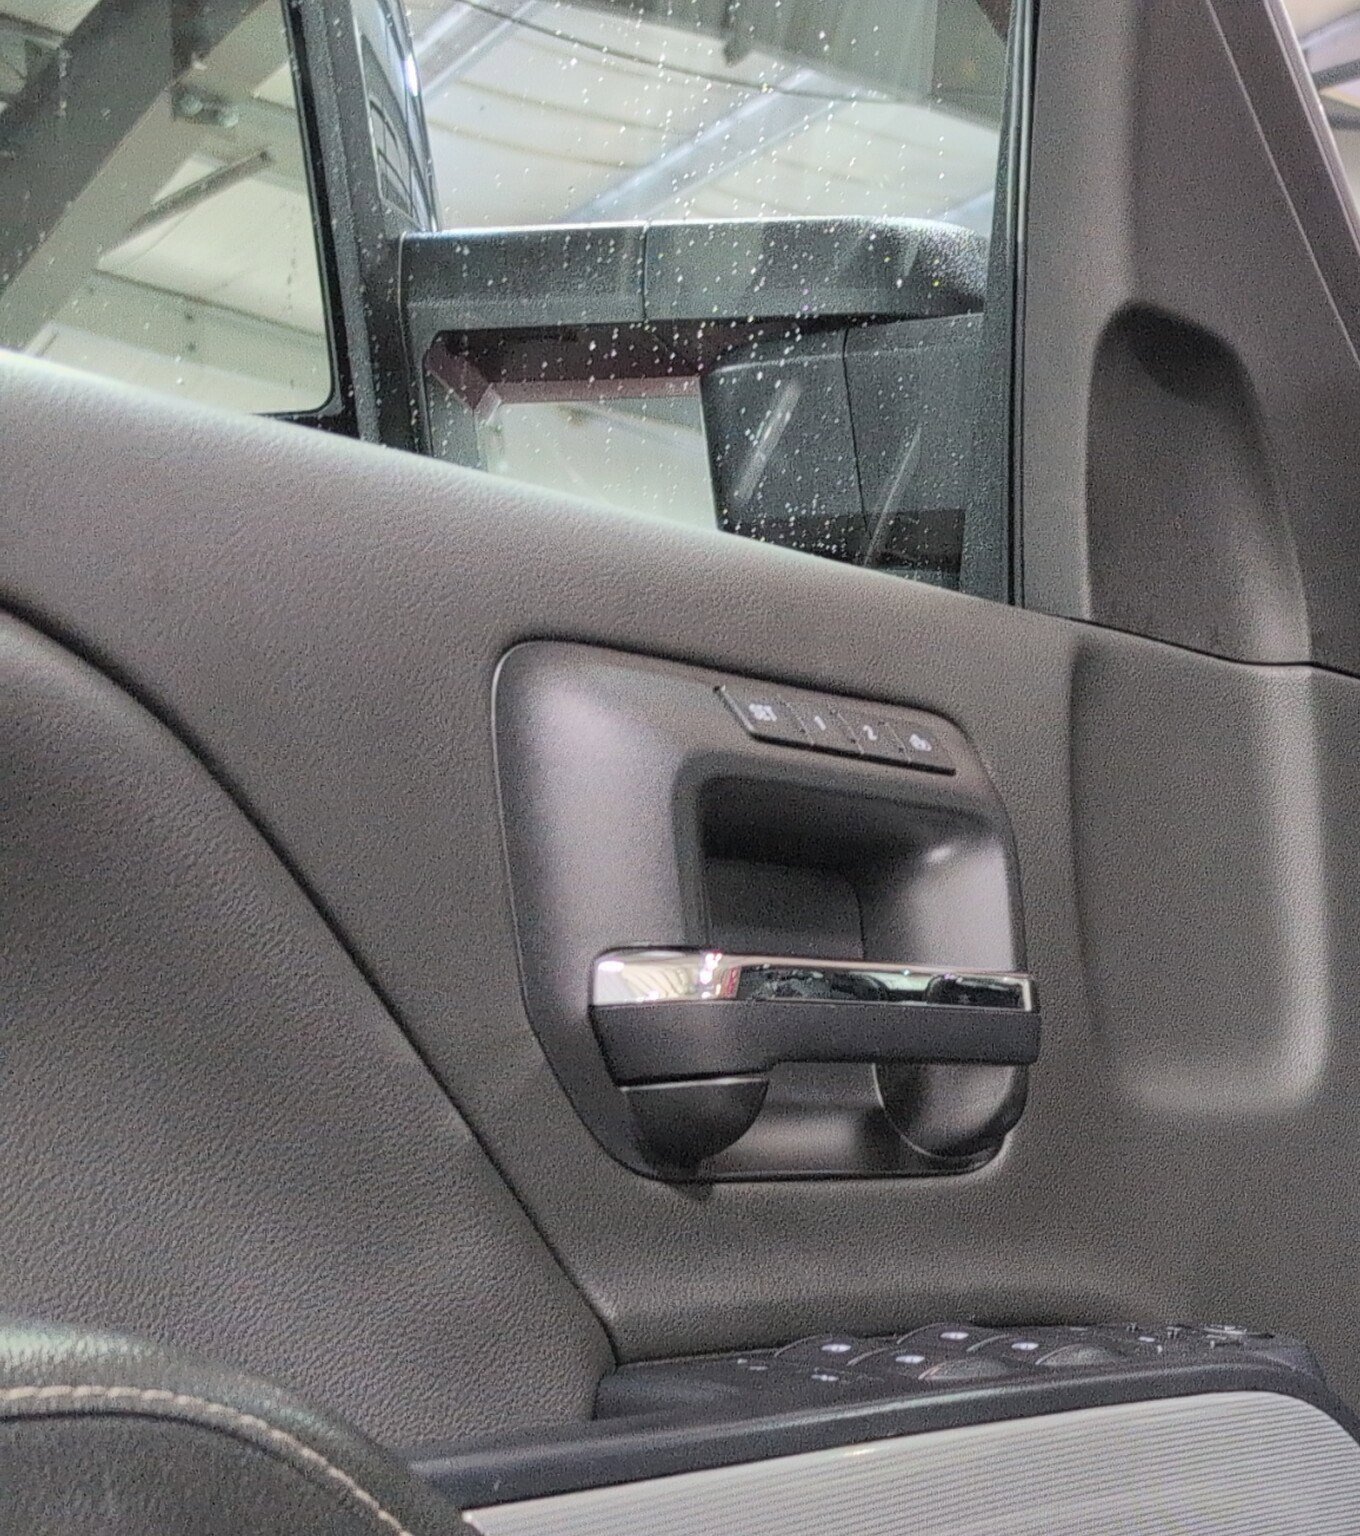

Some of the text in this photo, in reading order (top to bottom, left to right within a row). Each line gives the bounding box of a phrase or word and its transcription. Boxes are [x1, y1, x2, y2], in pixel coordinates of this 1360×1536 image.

[749, 703, 778, 722] SET
[813, 715, 827, 731] 1
[862, 724, 878, 741] 2
